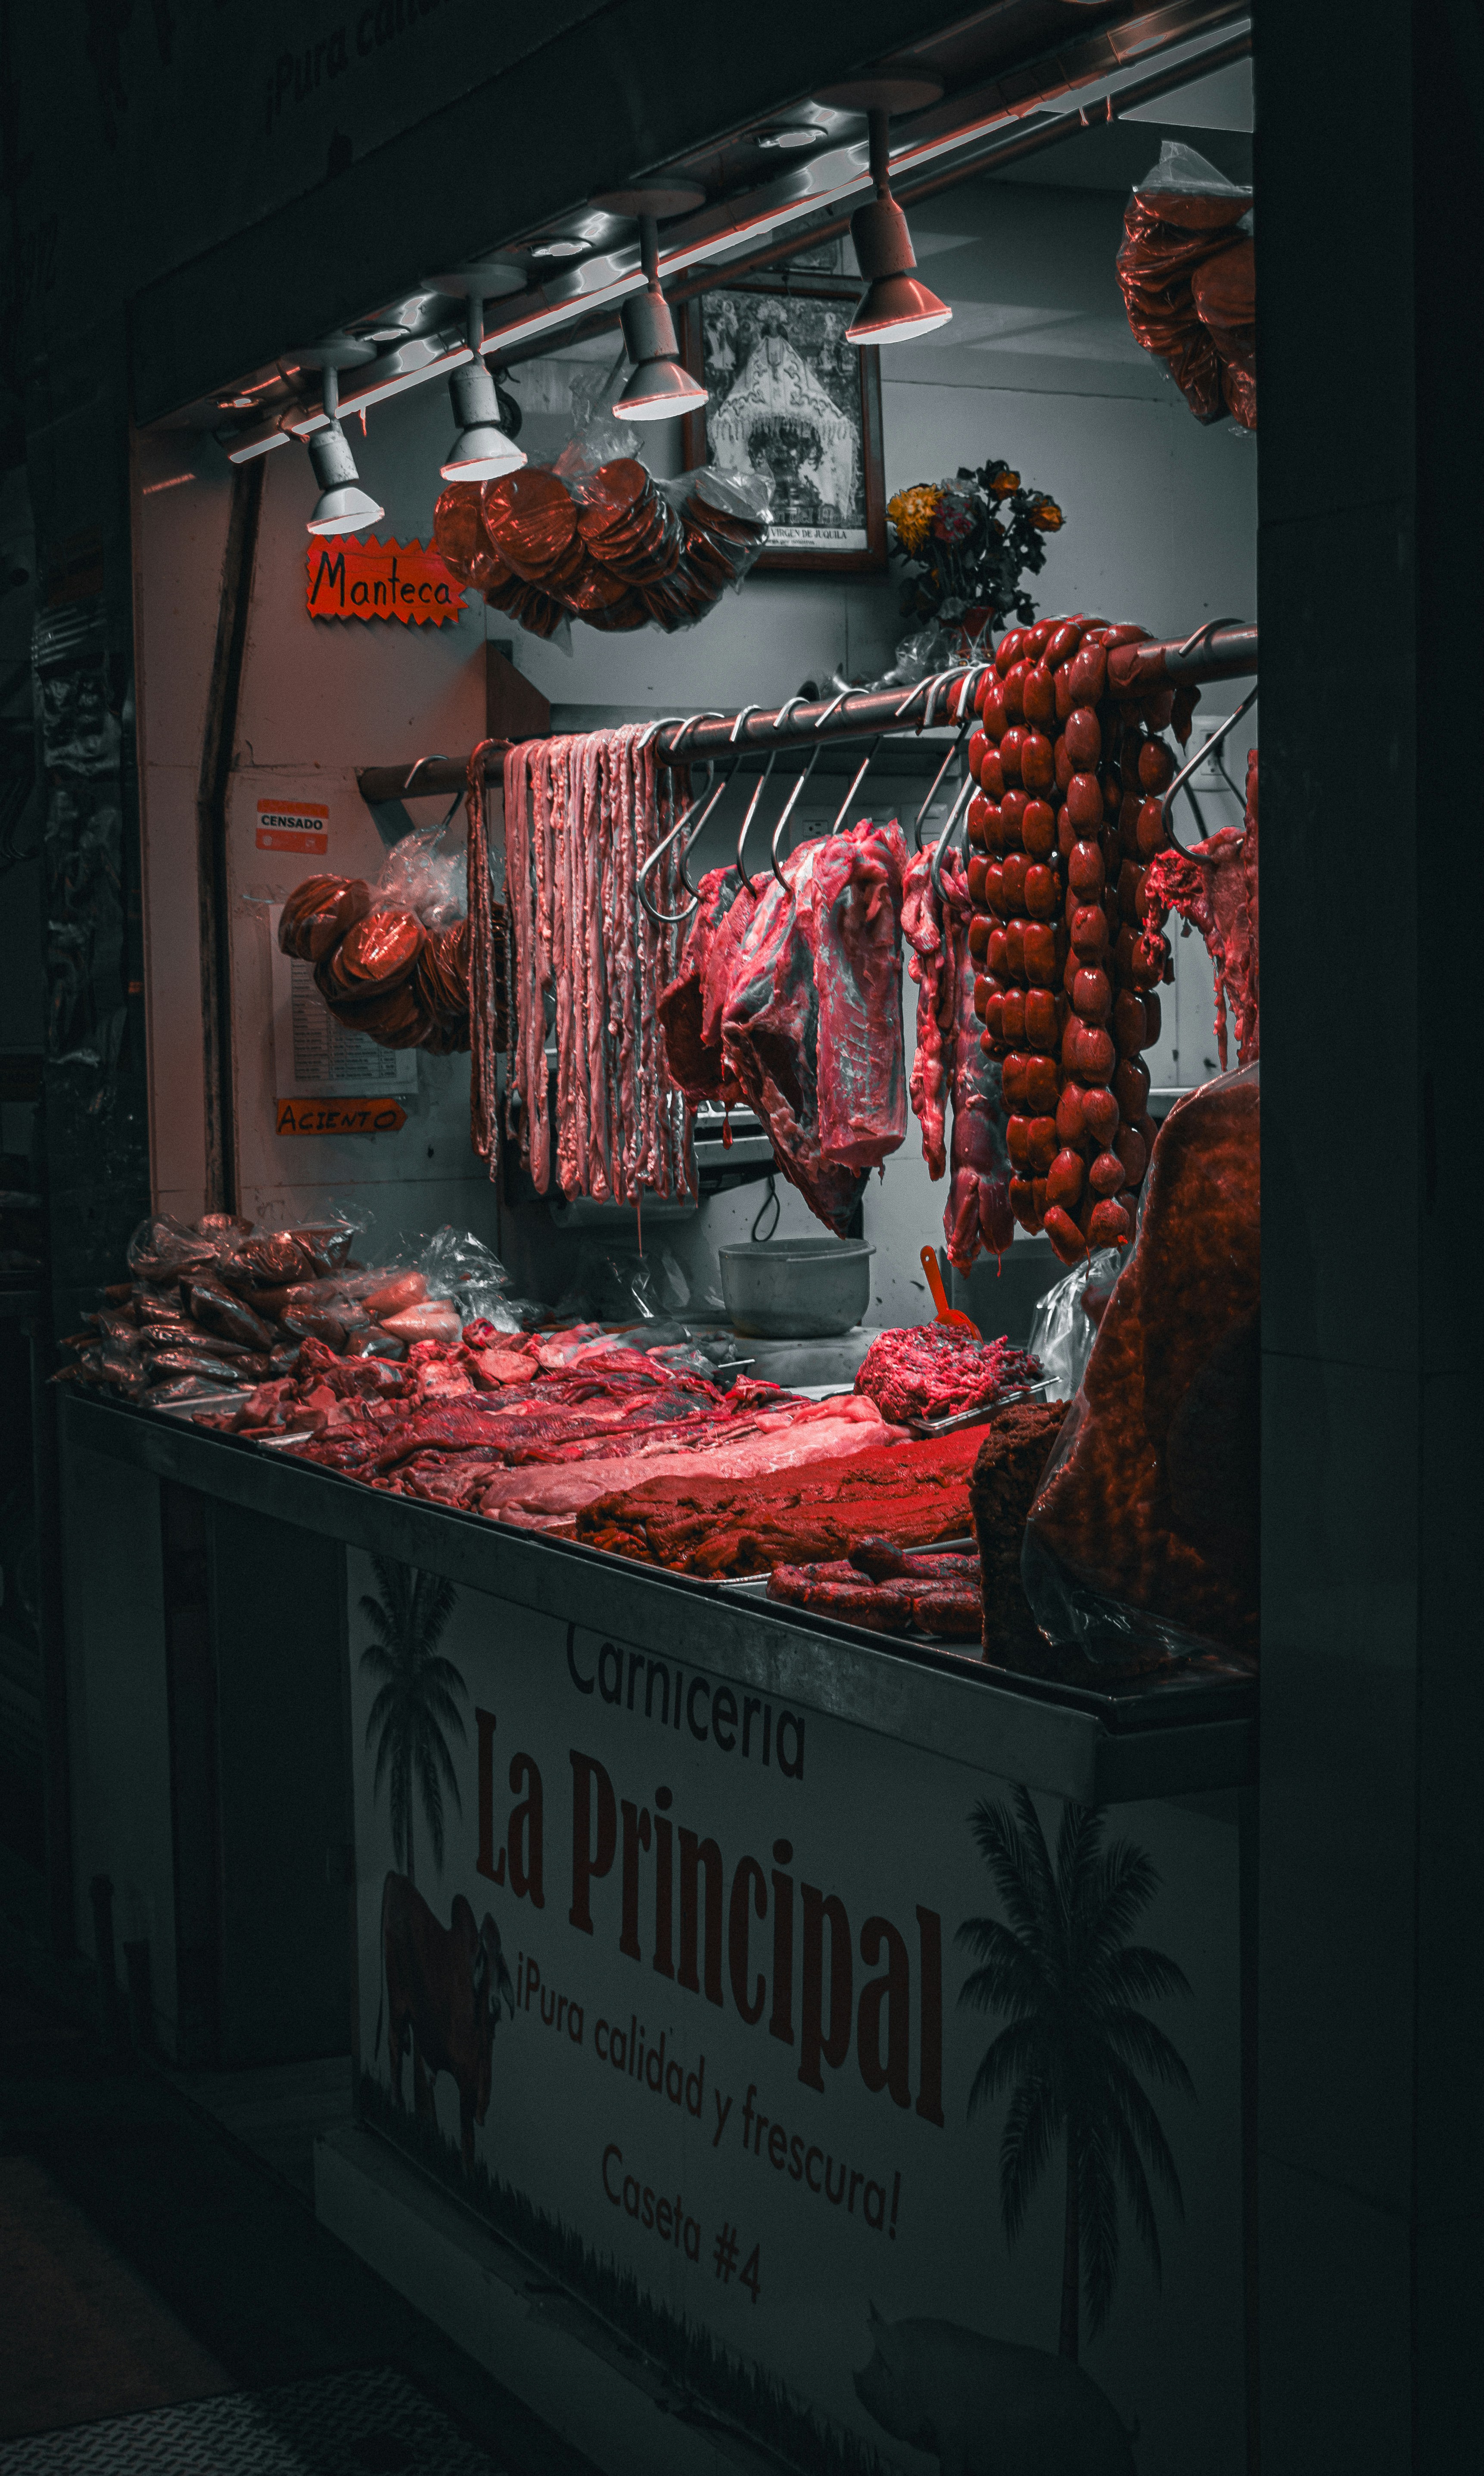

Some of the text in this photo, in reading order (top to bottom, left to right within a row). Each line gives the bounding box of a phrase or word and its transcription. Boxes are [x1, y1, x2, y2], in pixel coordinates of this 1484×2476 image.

[771, 528, 800, 538] VIRGEN
[802, 529, 812, 538] DE
[310, 551, 452, 607] Manteca
[261, 814, 323, 830] CENSADO
[278, 1105, 397, 1133] ACIENTO
[475, 1706, 945, 2129] La Principal
[517, 1951, 901, 2240] ¡Pura calidad y frescura!
[603, 2143, 761, 2304] Caseta #4
